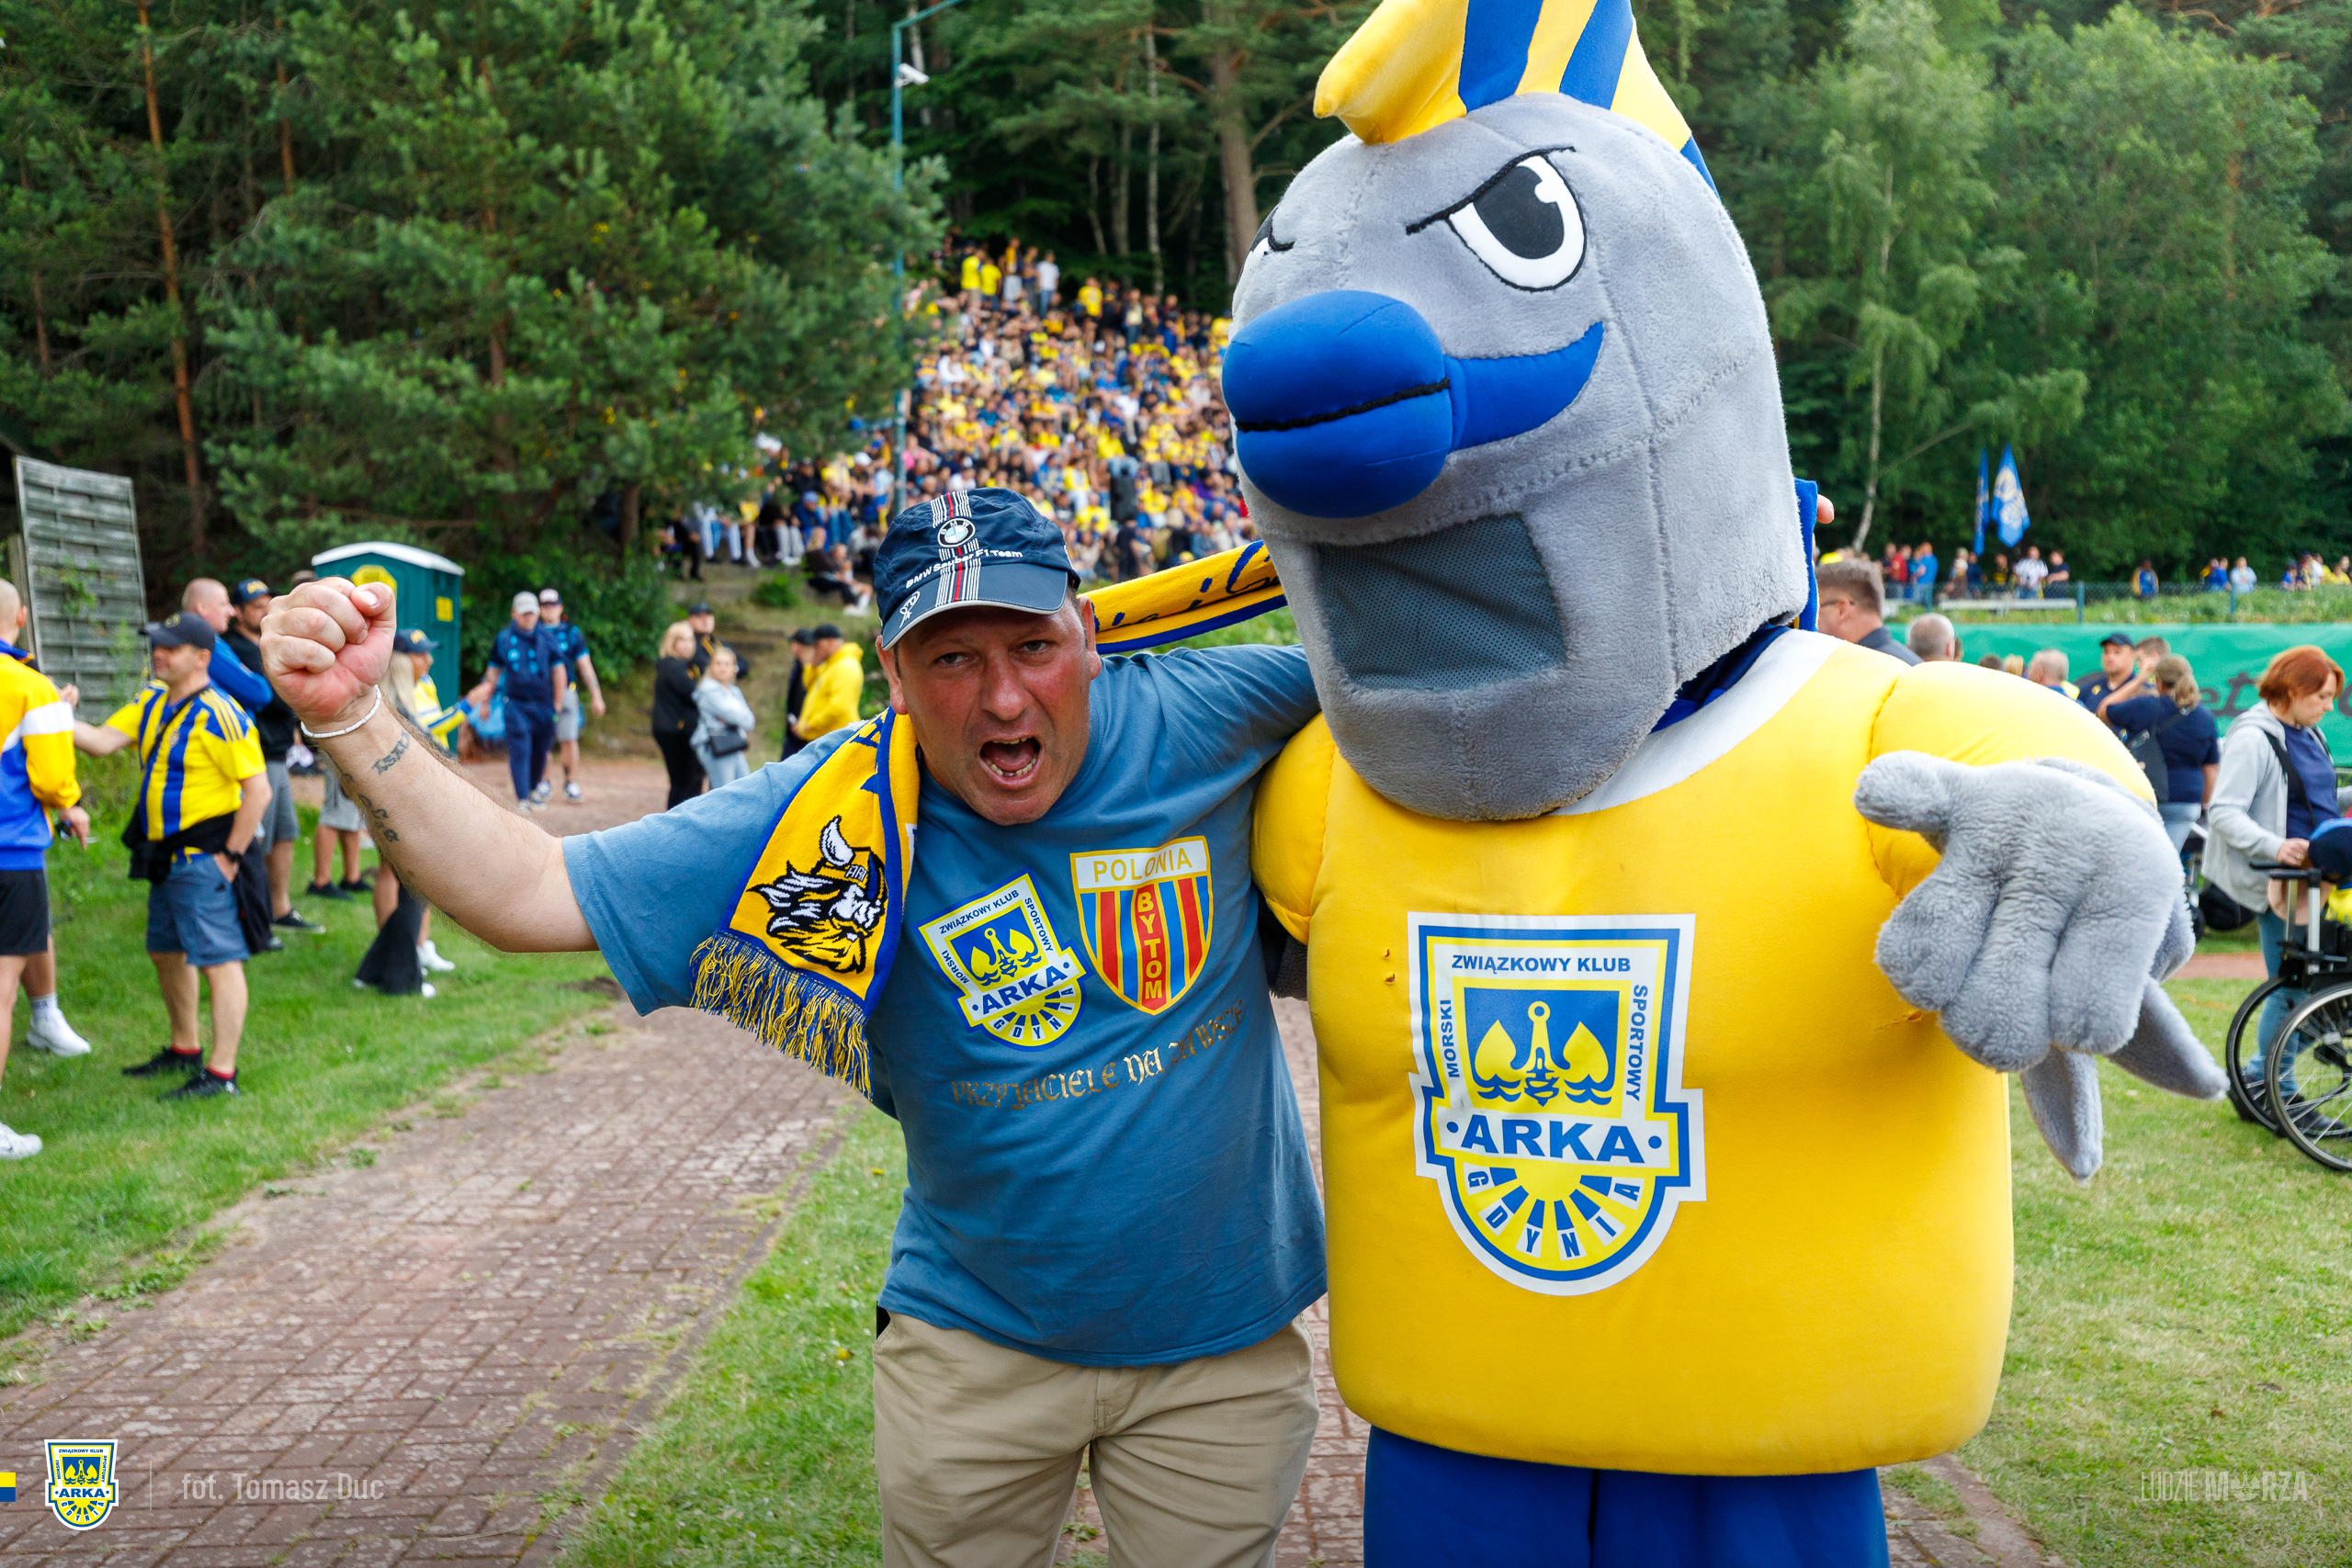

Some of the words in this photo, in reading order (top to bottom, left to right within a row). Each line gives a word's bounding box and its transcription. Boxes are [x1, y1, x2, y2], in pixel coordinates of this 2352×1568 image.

[940, 521, 970, 536] BMW
[906, 567, 933, 589] BMW
[933, 552, 975, 572] Sauber
[975, 548, 989, 558] F1
[989, 549, 1023, 558] Team
[1093, 848, 1193, 883] POLONIA
[939, 904, 992, 935] ZWIĄZKOWY
[992, 889, 1020, 908] KLUB
[1024, 897, 1054, 953] SPORTOWY
[942, 949, 970, 984] MORSKI
[1137, 891, 1163, 999] BYTOM
[1451, 954, 1571, 975] ZWIĄZKOWY
[1577, 956, 1631, 973] KLUB
[982, 965, 1069, 1015] ARKA
[992, 987, 1075, 1040] GDYNIA
[1436, 998, 1461, 1078] MORSKI
[1626, 984, 1648, 1102] SPORTOWY
[1460, 1113, 1645, 1165] ARKA
[1467, 1169, 1642, 1258] GDYNIA
